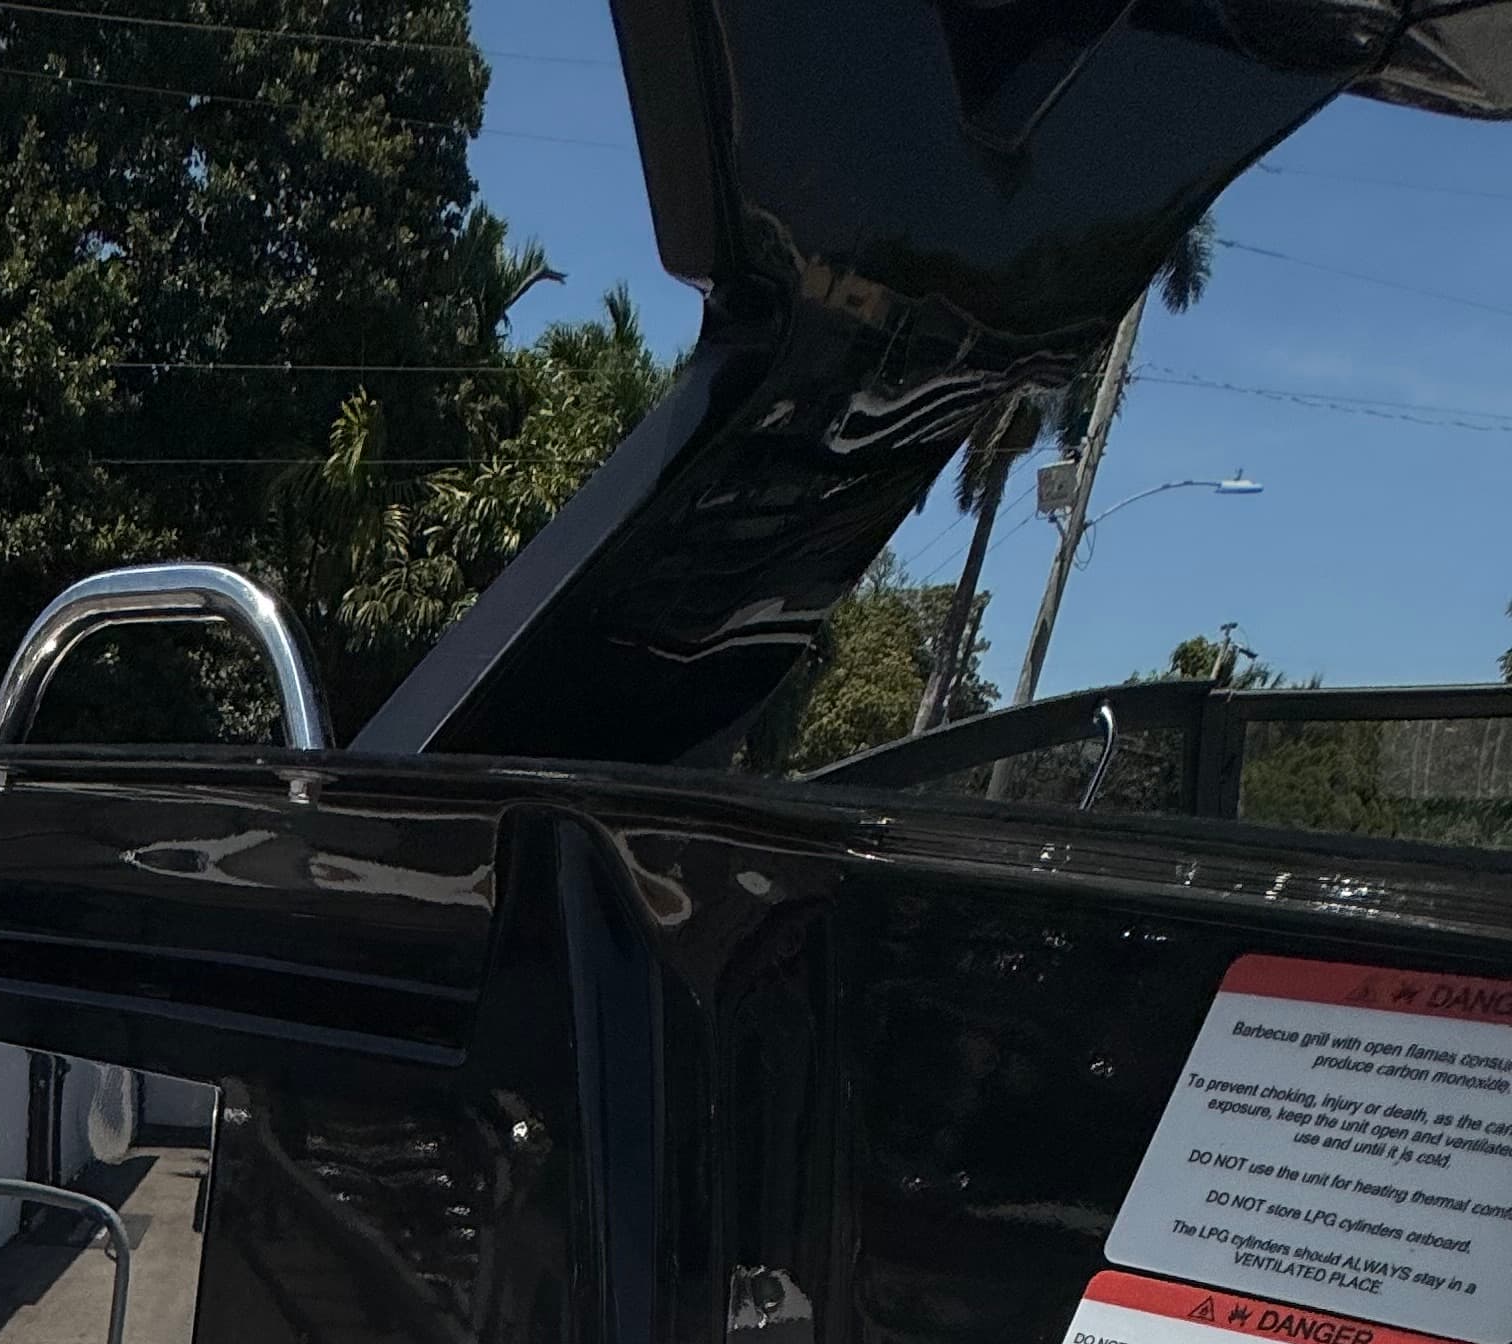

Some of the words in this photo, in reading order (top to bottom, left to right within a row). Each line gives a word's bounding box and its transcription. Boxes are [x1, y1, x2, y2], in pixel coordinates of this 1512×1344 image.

[1231, 1022, 1299, 1043] Barbecue
[1299, 1032, 1330, 1046] grill
[1331, 1037, 1362, 1051] with
[1362, 1041, 1403, 1056] open
[1404, 1045, 1457, 1064] flames
[1311, 1055, 1374, 1073] produce
[1375, 1064, 1430, 1081] carbon
[1187, 1073, 1205, 1088] To
[1205, 1079, 1259, 1096] prevent
[1259, 1086, 1317, 1107] choking,
[1320, 1094, 1364, 1113] injury
[1363, 1103, 1382, 1115] or
[1382, 1105, 1428, 1124] death,
[1432, 1113, 1454, 1126] as
[1456, 1116, 1482, 1130] the
[1207, 1098, 1272, 1120] exposure,
[1275, 1109, 1312, 1126] keep
[1313, 1115, 1338, 1128] the
[1339, 1119, 1370, 1134] unit
[1370, 1124, 1409, 1140] open
[1410, 1131, 1443, 1145] and
[1292, 1132, 1320, 1145] use
[1321, 1136, 1352, 1150] and
[1352, 1142, 1386, 1156] until
[1385, 1145, 1399, 1159] it
[1398, 1147, 1413, 1162] is
[1187, 1149, 1212, 1165] DO
[1212, 1154, 1248, 1171] NOT
[1247, 1163, 1274, 1176] use
[1275, 1166, 1299, 1180] the
[1301, 1172, 1330, 1186] unit
[1329, 1176, 1352, 1190] for
[1351, 1180, 1408, 1203] heating
[1205, 1190, 1230, 1206] DO
[1230, 1195, 1267, 1212] NOT
[1265, 1204, 1302, 1219] store
[1303, 1209, 1337, 1226] LPG
[1338, 1218, 1403, 1240] cylinders
[1172, 1219, 1197, 1236] The
[1197, 1225, 1230, 1242] LPG
[1230, 1234, 1291, 1255] cylinders
[1292, 1246, 1342, 1265] should
[1340, 1256, 1412, 1281] ALWAYS
[1412, 1272, 1446, 1288] stay
[1447, 1277, 1462, 1291] in
[1463, 1282, 1476, 1294] a
[1234, 1250, 1326, 1281] VENTILATED
